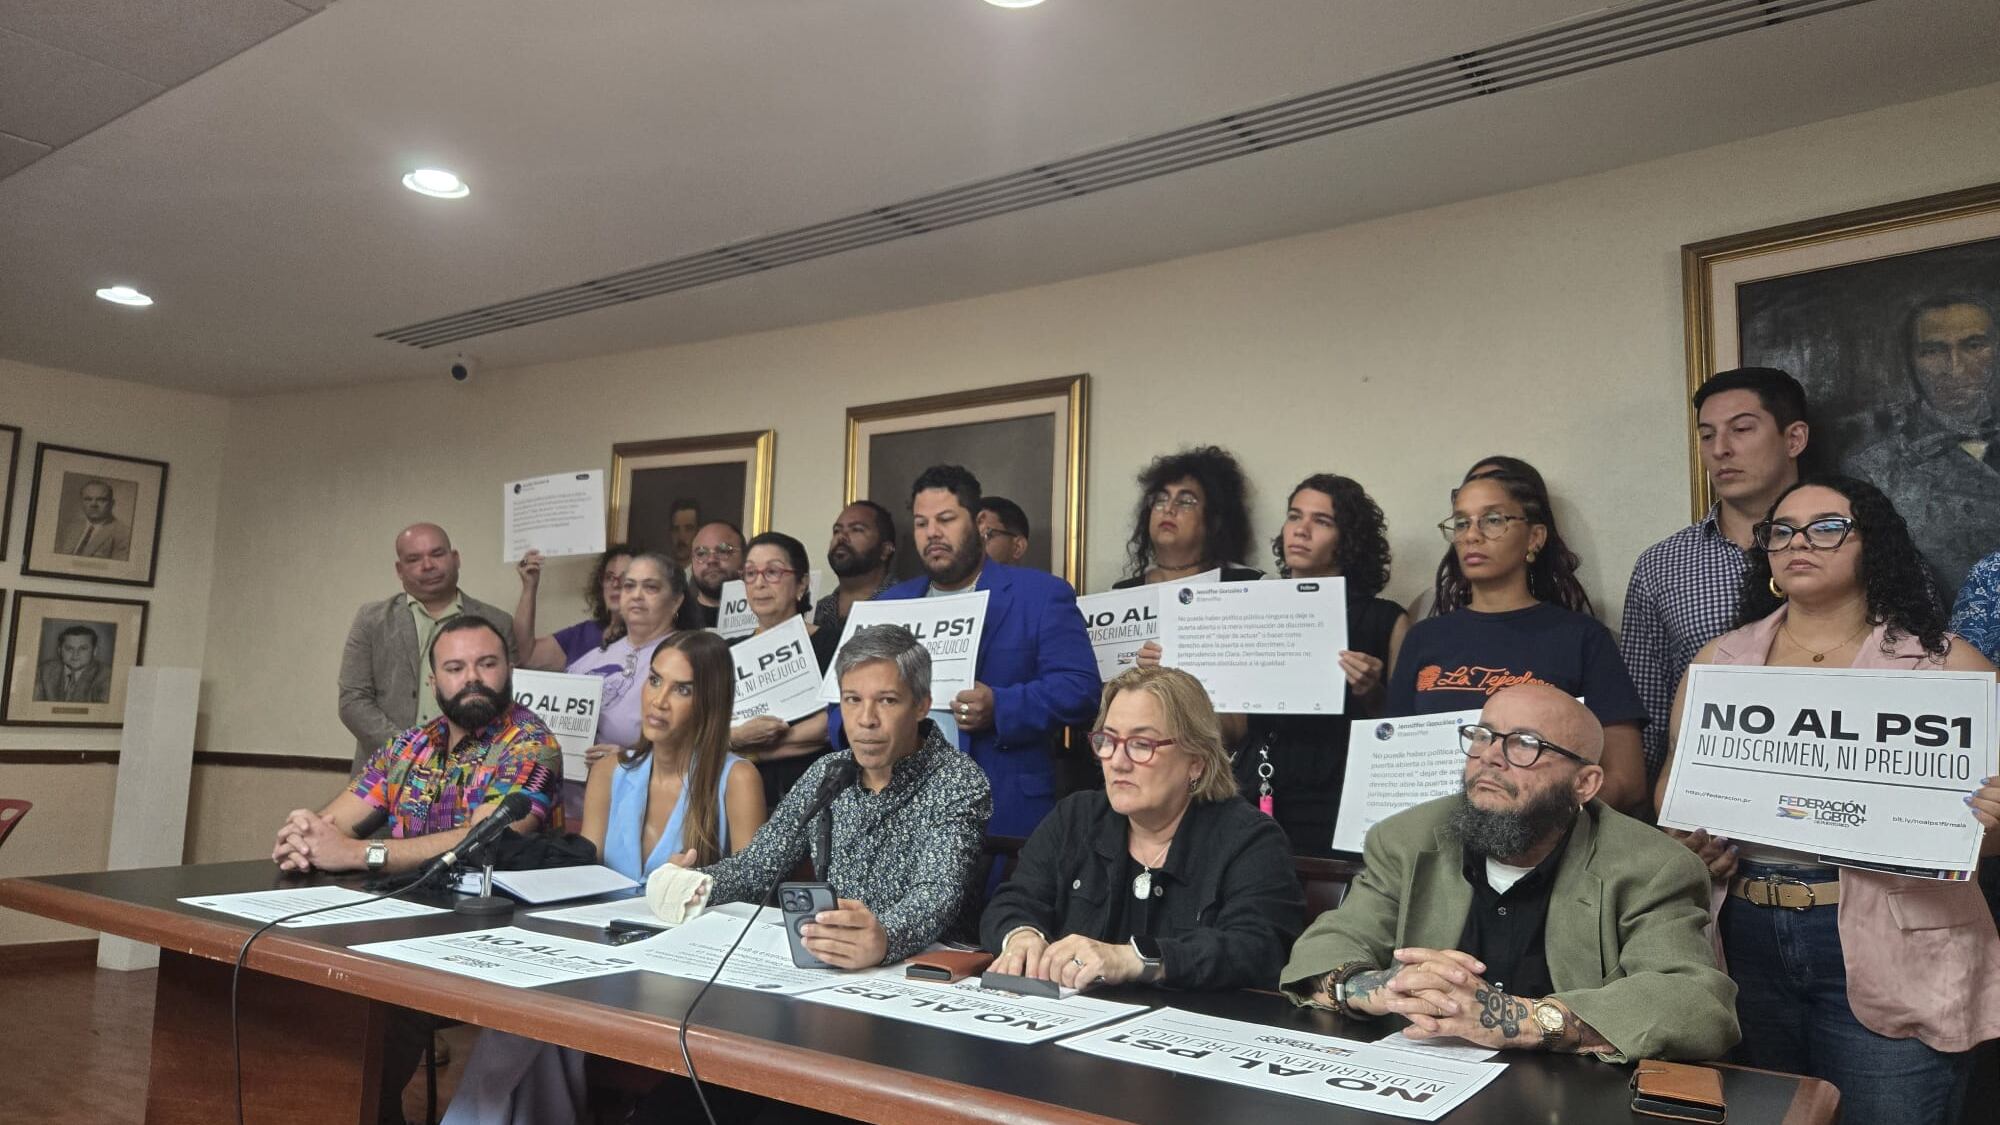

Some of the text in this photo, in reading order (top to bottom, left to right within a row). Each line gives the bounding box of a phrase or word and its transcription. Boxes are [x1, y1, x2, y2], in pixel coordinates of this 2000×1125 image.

[725, 599, 747, 615] NO
[1122, 606, 1158, 623] AL
[933, 617, 975, 639] PS1
[1146, 621, 1157, 635] NI
[926, 638, 969, 656] PREJUICIO
[737, 640, 803, 680] L PS1
[745, 677, 757, 692] NI
[759, 656, 807, 685] PREJUICIO
[1437, 666, 1554, 695] La Tejed
[515, 692, 595, 716] O AL PS1
[1701, 703, 1972, 748] NO AL PS1
[1697, 734, 1970, 780] NI DISCRIMEN, NI PREJUICIO
[1778, 794, 1867, 815] FEDERACIÓN
[1814, 809, 1867, 826] LGBTQ+
[466, 934, 567, 956] NO AL
[854, 980, 926, 997] PREJUIC
[833, 986, 1058, 1031] NO AL PS
[1129, 1028, 1239, 1053] PREJUICIO
[1243, 1048, 1270, 1059] NI
[1106, 1034, 1434, 1103] NO AL PS1
[1275, 1052, 1411, 1087] DISCRIMEN,
[1414, 1081, 1446, 1093] NI
